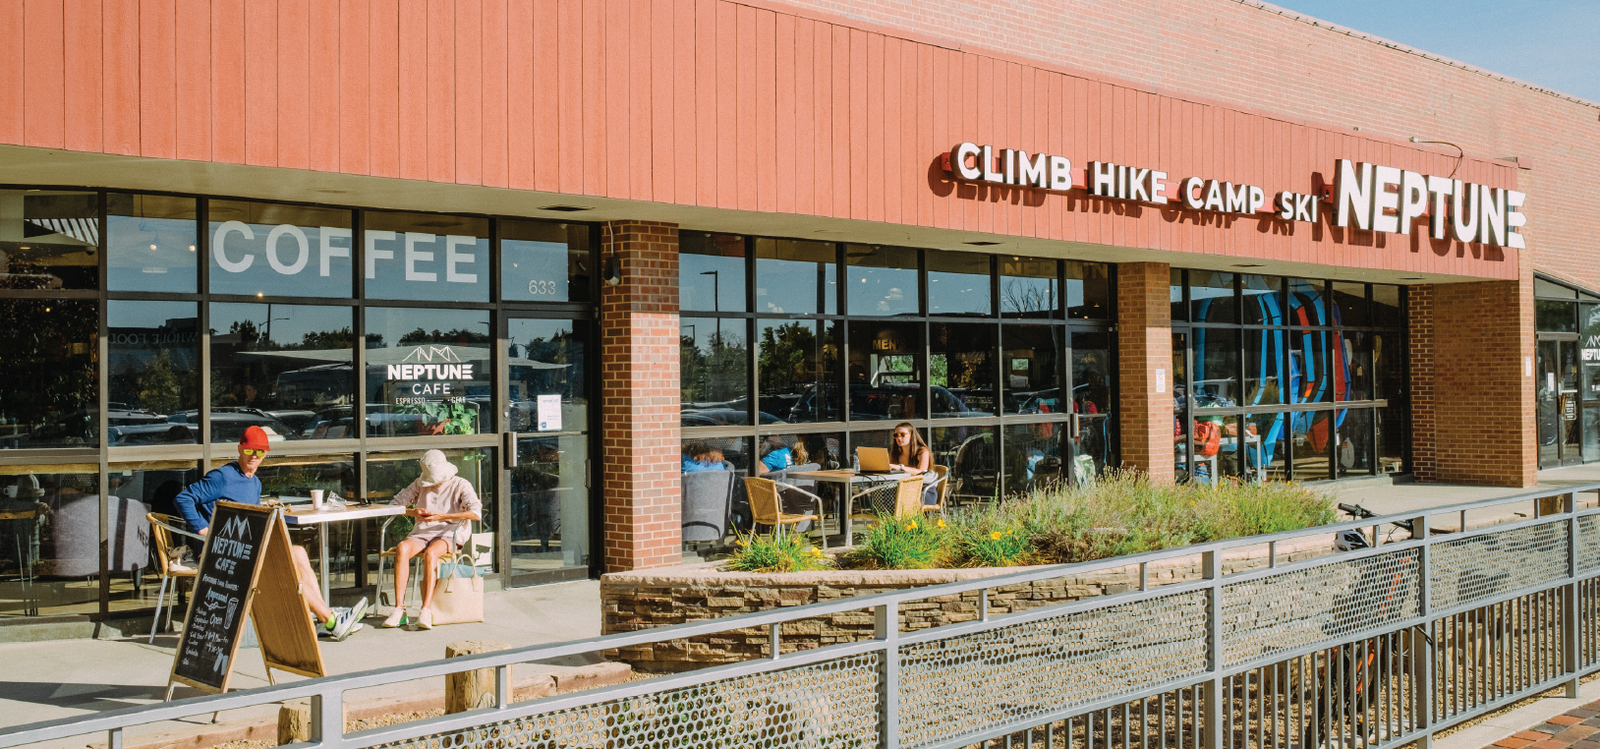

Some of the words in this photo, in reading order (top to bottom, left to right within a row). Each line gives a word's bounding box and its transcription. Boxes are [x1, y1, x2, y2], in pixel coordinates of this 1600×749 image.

[955, 142, 1073, 191] CLIMB
[1093, 160, 1168, 205] HIKE
[1185, 176, 1265, 215] CAMP
[1280, 190, 1318, 223] SKI
[1335, 158, 1527, 249] NEPTUNE
[212, 220, 478, 284] COFFEE
[528, 280, 556, 295] 633
[387, 364, 474, 380] NEPTUNE
[412, 383, 451, 395] CAFE
[395, 397, 426, 405] ESPRESSO
[211, 536, 253, 560] NEPTUNE
[215, 557, 237, 575] CAFE
[209, 613, 223, 627] Open
